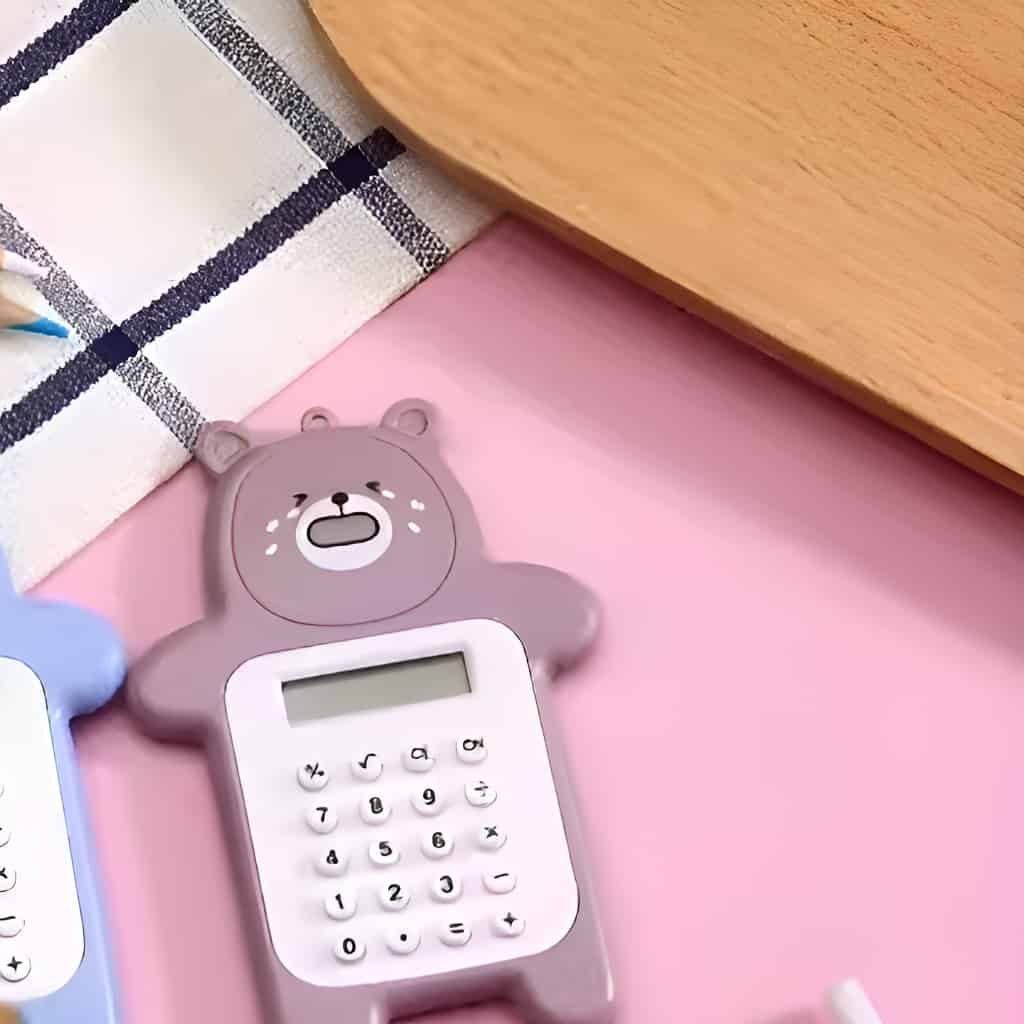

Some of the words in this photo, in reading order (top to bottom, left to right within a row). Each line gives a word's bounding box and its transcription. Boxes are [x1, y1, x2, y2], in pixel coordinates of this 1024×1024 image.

[315, 806, 329, 823] 7
[422, 788, 436, 806] 9
[378, 840, 393, 857] 5
[431, 831, 446, 849] 6
[387, 883, 403, 902] 2
[439, 875, 454, 894] 3
[342, 937, 357, 955] 0
